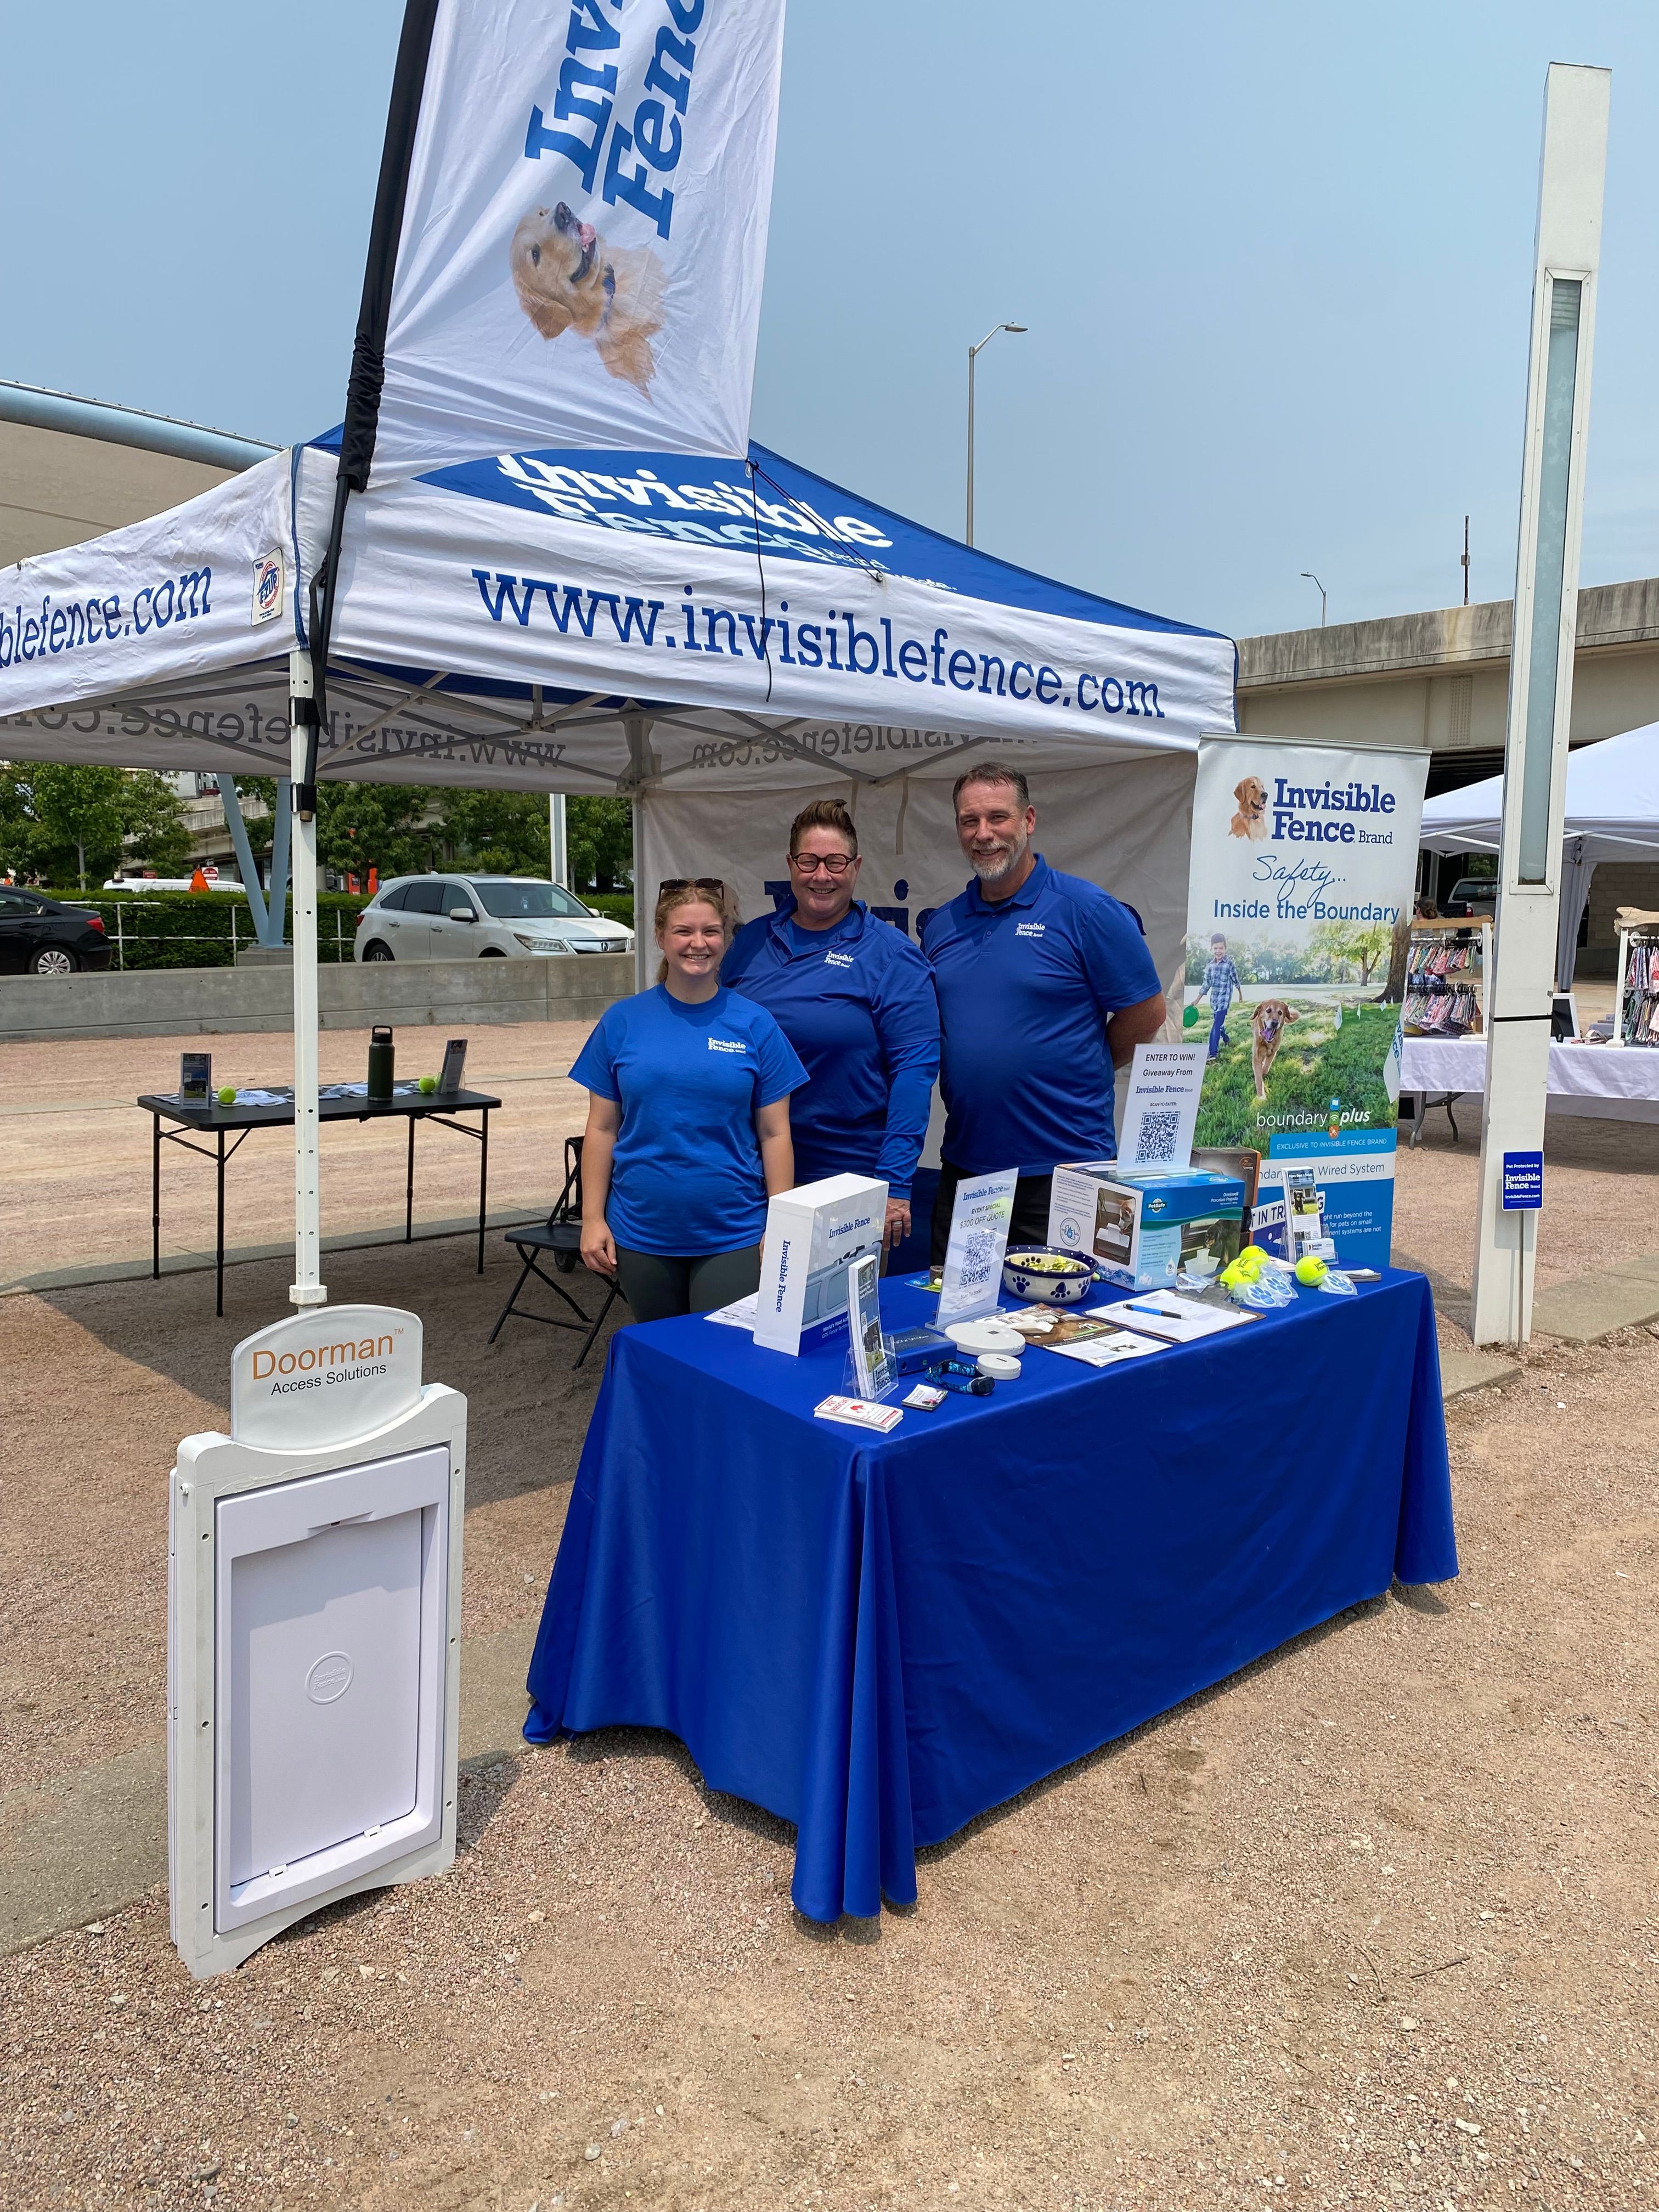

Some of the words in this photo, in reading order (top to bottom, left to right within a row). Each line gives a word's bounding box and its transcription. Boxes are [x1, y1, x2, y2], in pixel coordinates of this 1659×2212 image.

[496, 454, 893, 548] Invisible
[471, 569, 1166, 718] www.invisiblefence.com
[1273, 778, 1396, 813] Invisible
[1271, 811, 1355, 843] Fence
[1358, 831, 1393, 844] Brand
[1214, 899, 1270, 919] Inside
[1277, 901, 1307, 919] the
[1314, 901, 1400, 924] Boundary
[1015, 929, 1033, 937] Fence
[1017, 922, 1046, 930] Invisible
[824, 957, 841, 966] Fence
[826, 950, 854, 963] Invisible
[708, 1037, 746, 1049] Invisible
[1143, 1069, 1175, 1077] Giveaway
[1256, 1110, 1328, 1127] boundary
[1339, 1108, 1371, 1125] plus
[1318, 1165, 1347, 1176] Wired
[1350, 1164, 1385, 1177] System
[1505, 1173, 1541, 1182] Invisible
[962, 1188, 988, 1201] Invisible
[985, 1203, 1001, 1211] SPECIAL
[960, 1219, 974, 1229] $300
[974, 1215, 986, 1225] OFF
[987, 1210, 1006, 1222] QUOTE
[1258, 1209, 1268, 1226] IN
[1338, 1221, 1350, 1229] pets
[828, 1223, 854, 1239] Invisible
[854, 1216, 871, 1229] Fence
[1341, 1228, 1362, 1236] systems
[778, 1240, 791, 1283] Invisible
[775, 1284, 787, 1313] Fence
[252, 1334, 394, 1380] Doorman
[270, 1376, 321, 1396] Access
[326, 1363, 387, 1385] Solutions
